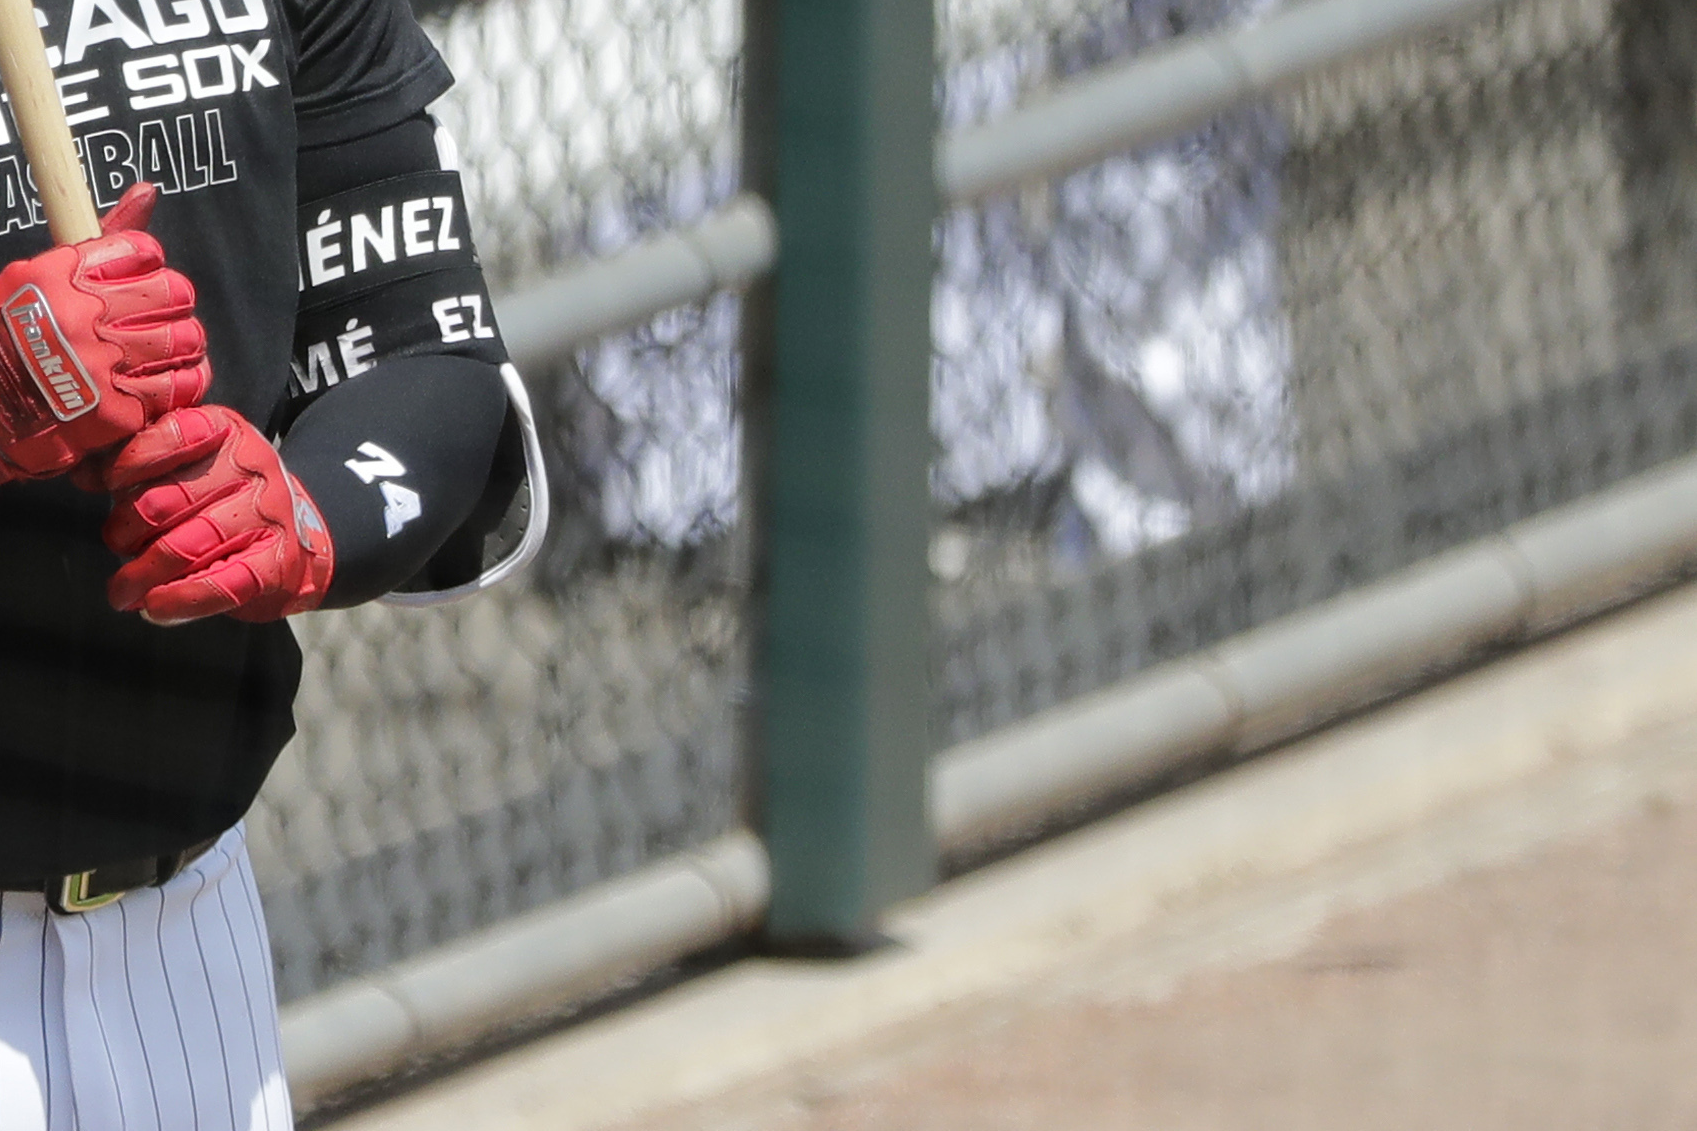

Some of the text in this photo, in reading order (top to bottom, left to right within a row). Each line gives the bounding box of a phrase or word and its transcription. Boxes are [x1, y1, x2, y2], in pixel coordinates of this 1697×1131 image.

[121, 39, 280, 111] SOX
[298, 196, 460, 292] ÉNEZ
[9, 300, 85, 410] Franklin
